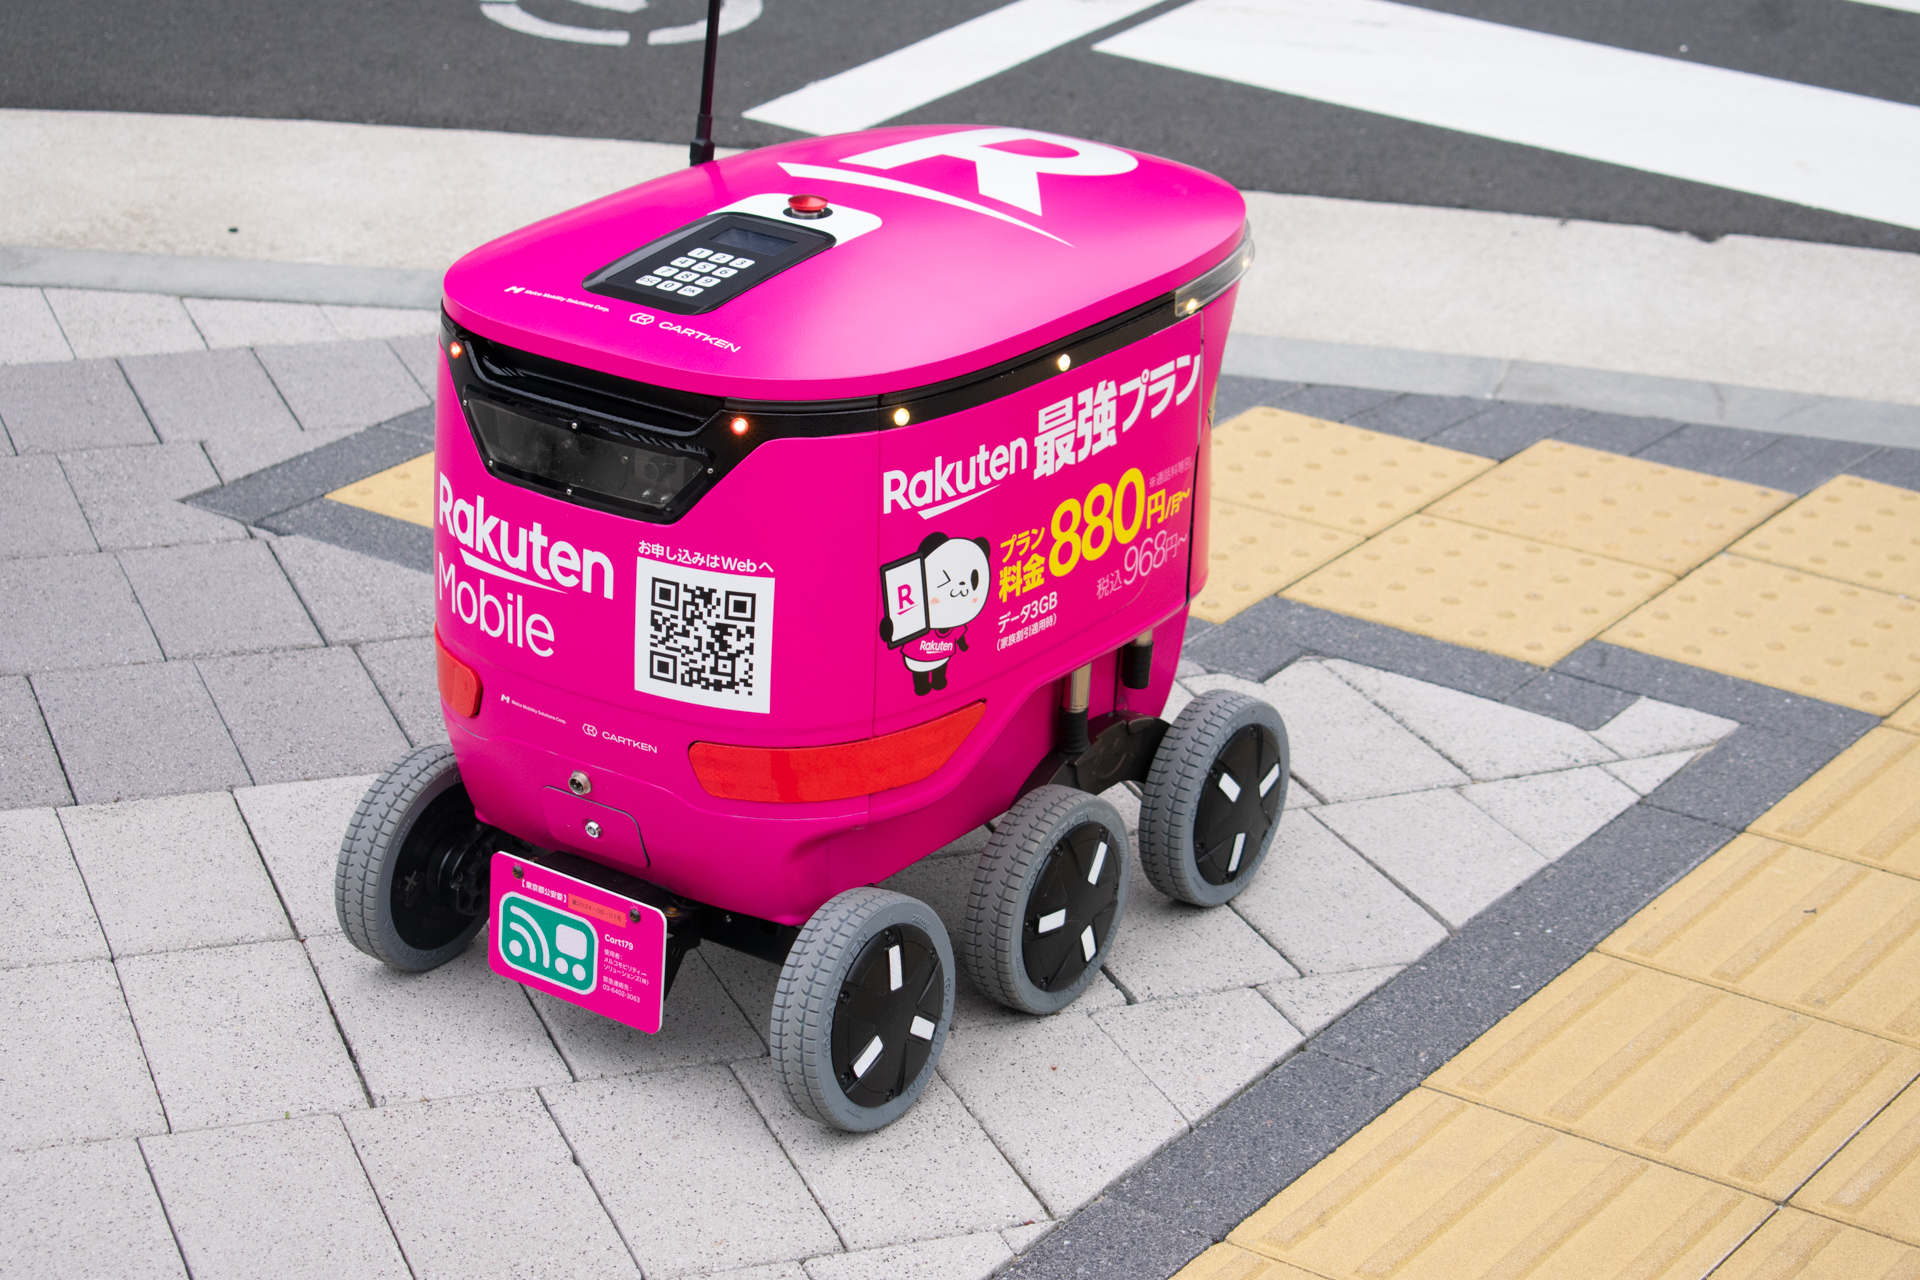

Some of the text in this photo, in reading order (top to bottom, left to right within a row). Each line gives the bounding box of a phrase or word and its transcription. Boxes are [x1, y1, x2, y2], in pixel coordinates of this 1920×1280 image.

[543, 292, 567, 302] Mobility
[566, 298, 594, 309] Solutions
[658, 321, 742, 353] CARTKEN
[883, 354, 1201, 515] Rakuten 最強プラン
[438, 471, 614, 600] Rakuten
[1000, 527, 1045, 564] プラン
[637, 540, 774, 574] お申し込みはWebへ
[998, 553, 1046, 603] 料金
[438, 551, 555, 657] Mobile
[998, 591, 1058, 633] データ3GB
[919, 640, 953, 652] Rakuten
[601, 731, 658, 754] CARTKEN
[604, 934, 634, 951] Cart179
